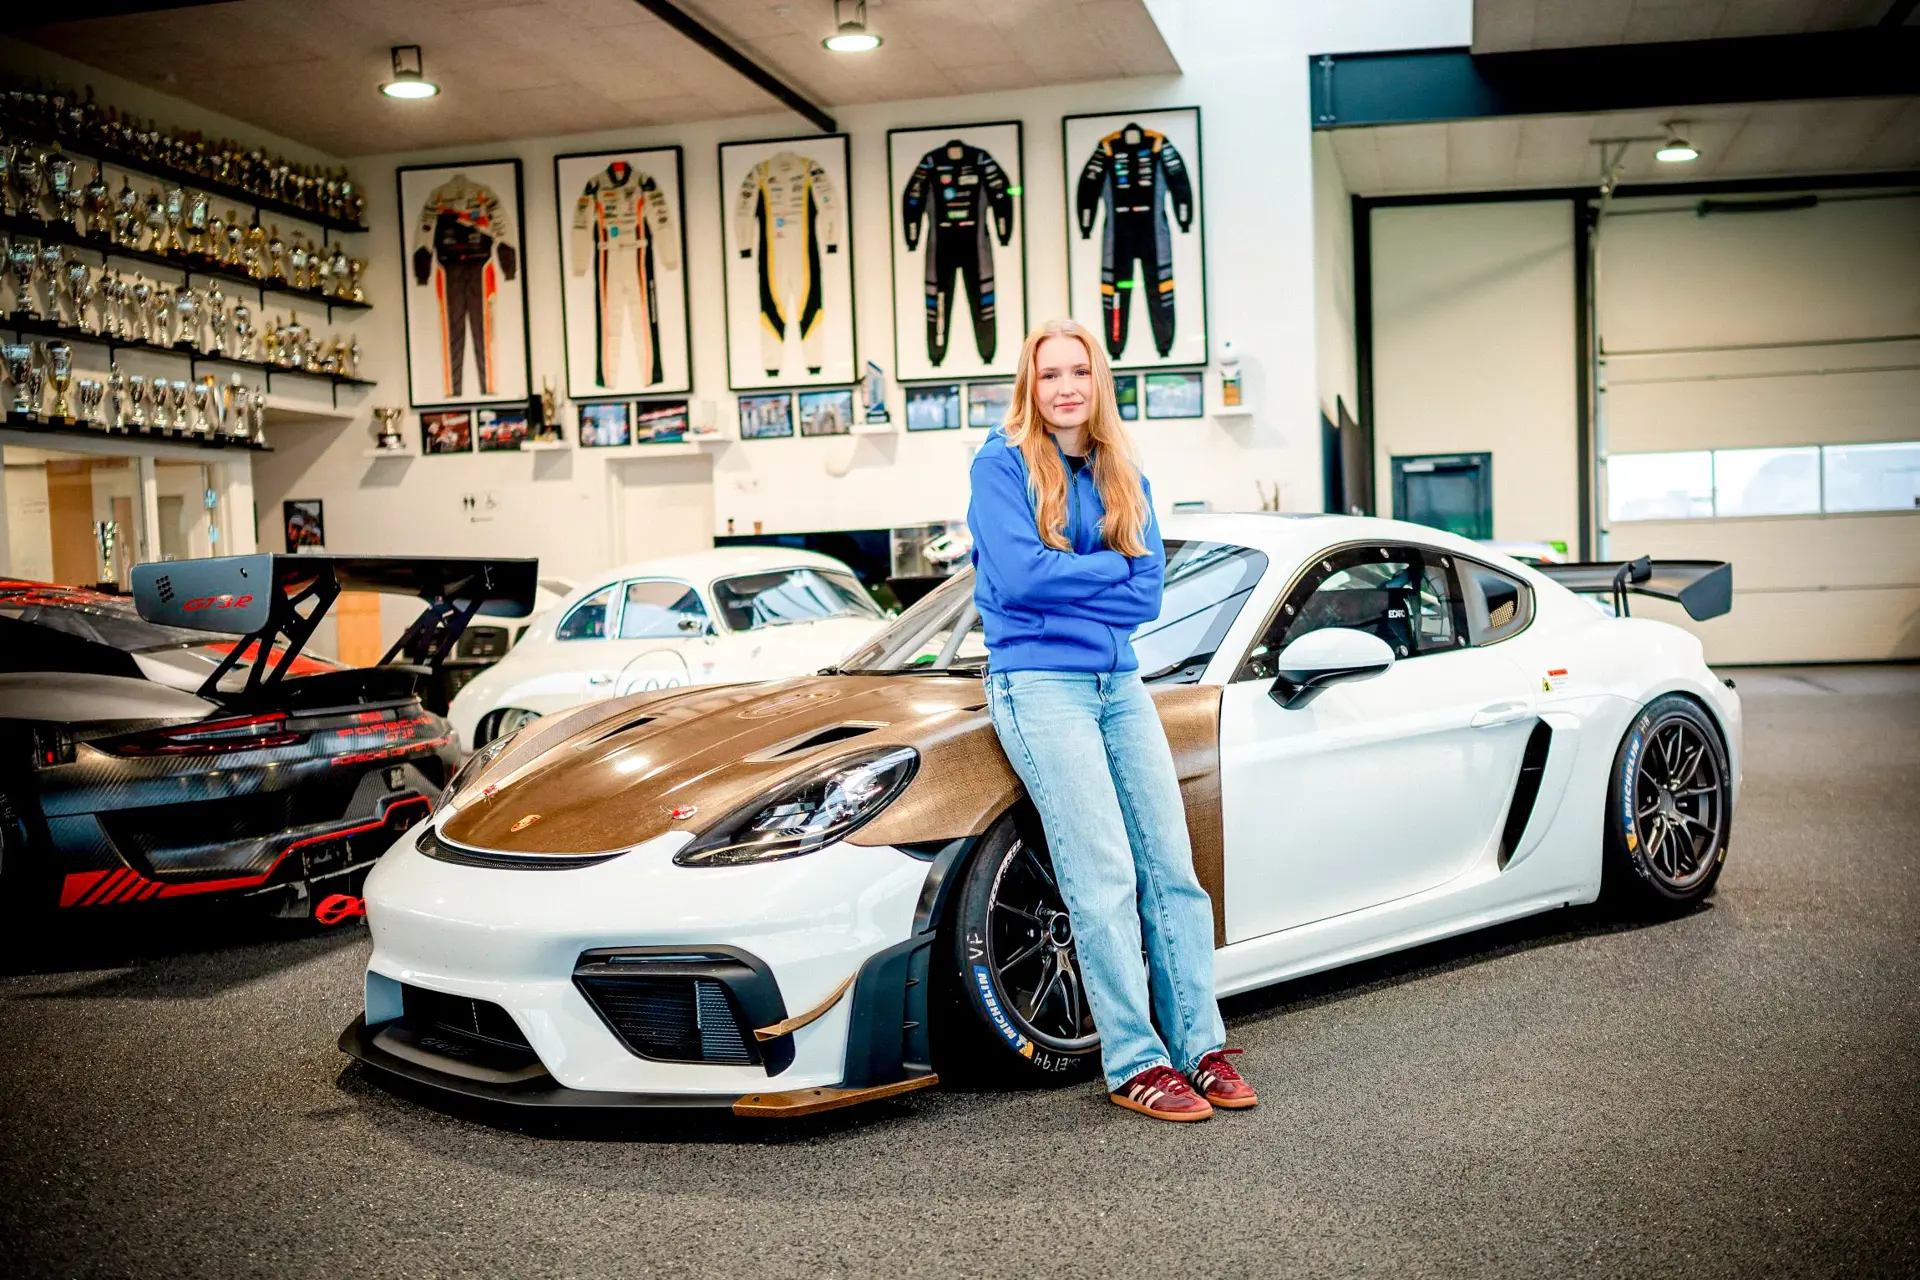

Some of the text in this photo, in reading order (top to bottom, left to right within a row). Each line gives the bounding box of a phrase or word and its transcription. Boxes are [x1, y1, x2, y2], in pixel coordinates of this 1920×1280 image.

[183, 594, 253, 611] GT3R
[336, 717, 433, 738] PORSCHE
[1624, 739, 1640, 818] MICHELIN
[977, 972, 1017, 1040] MICHELIN
